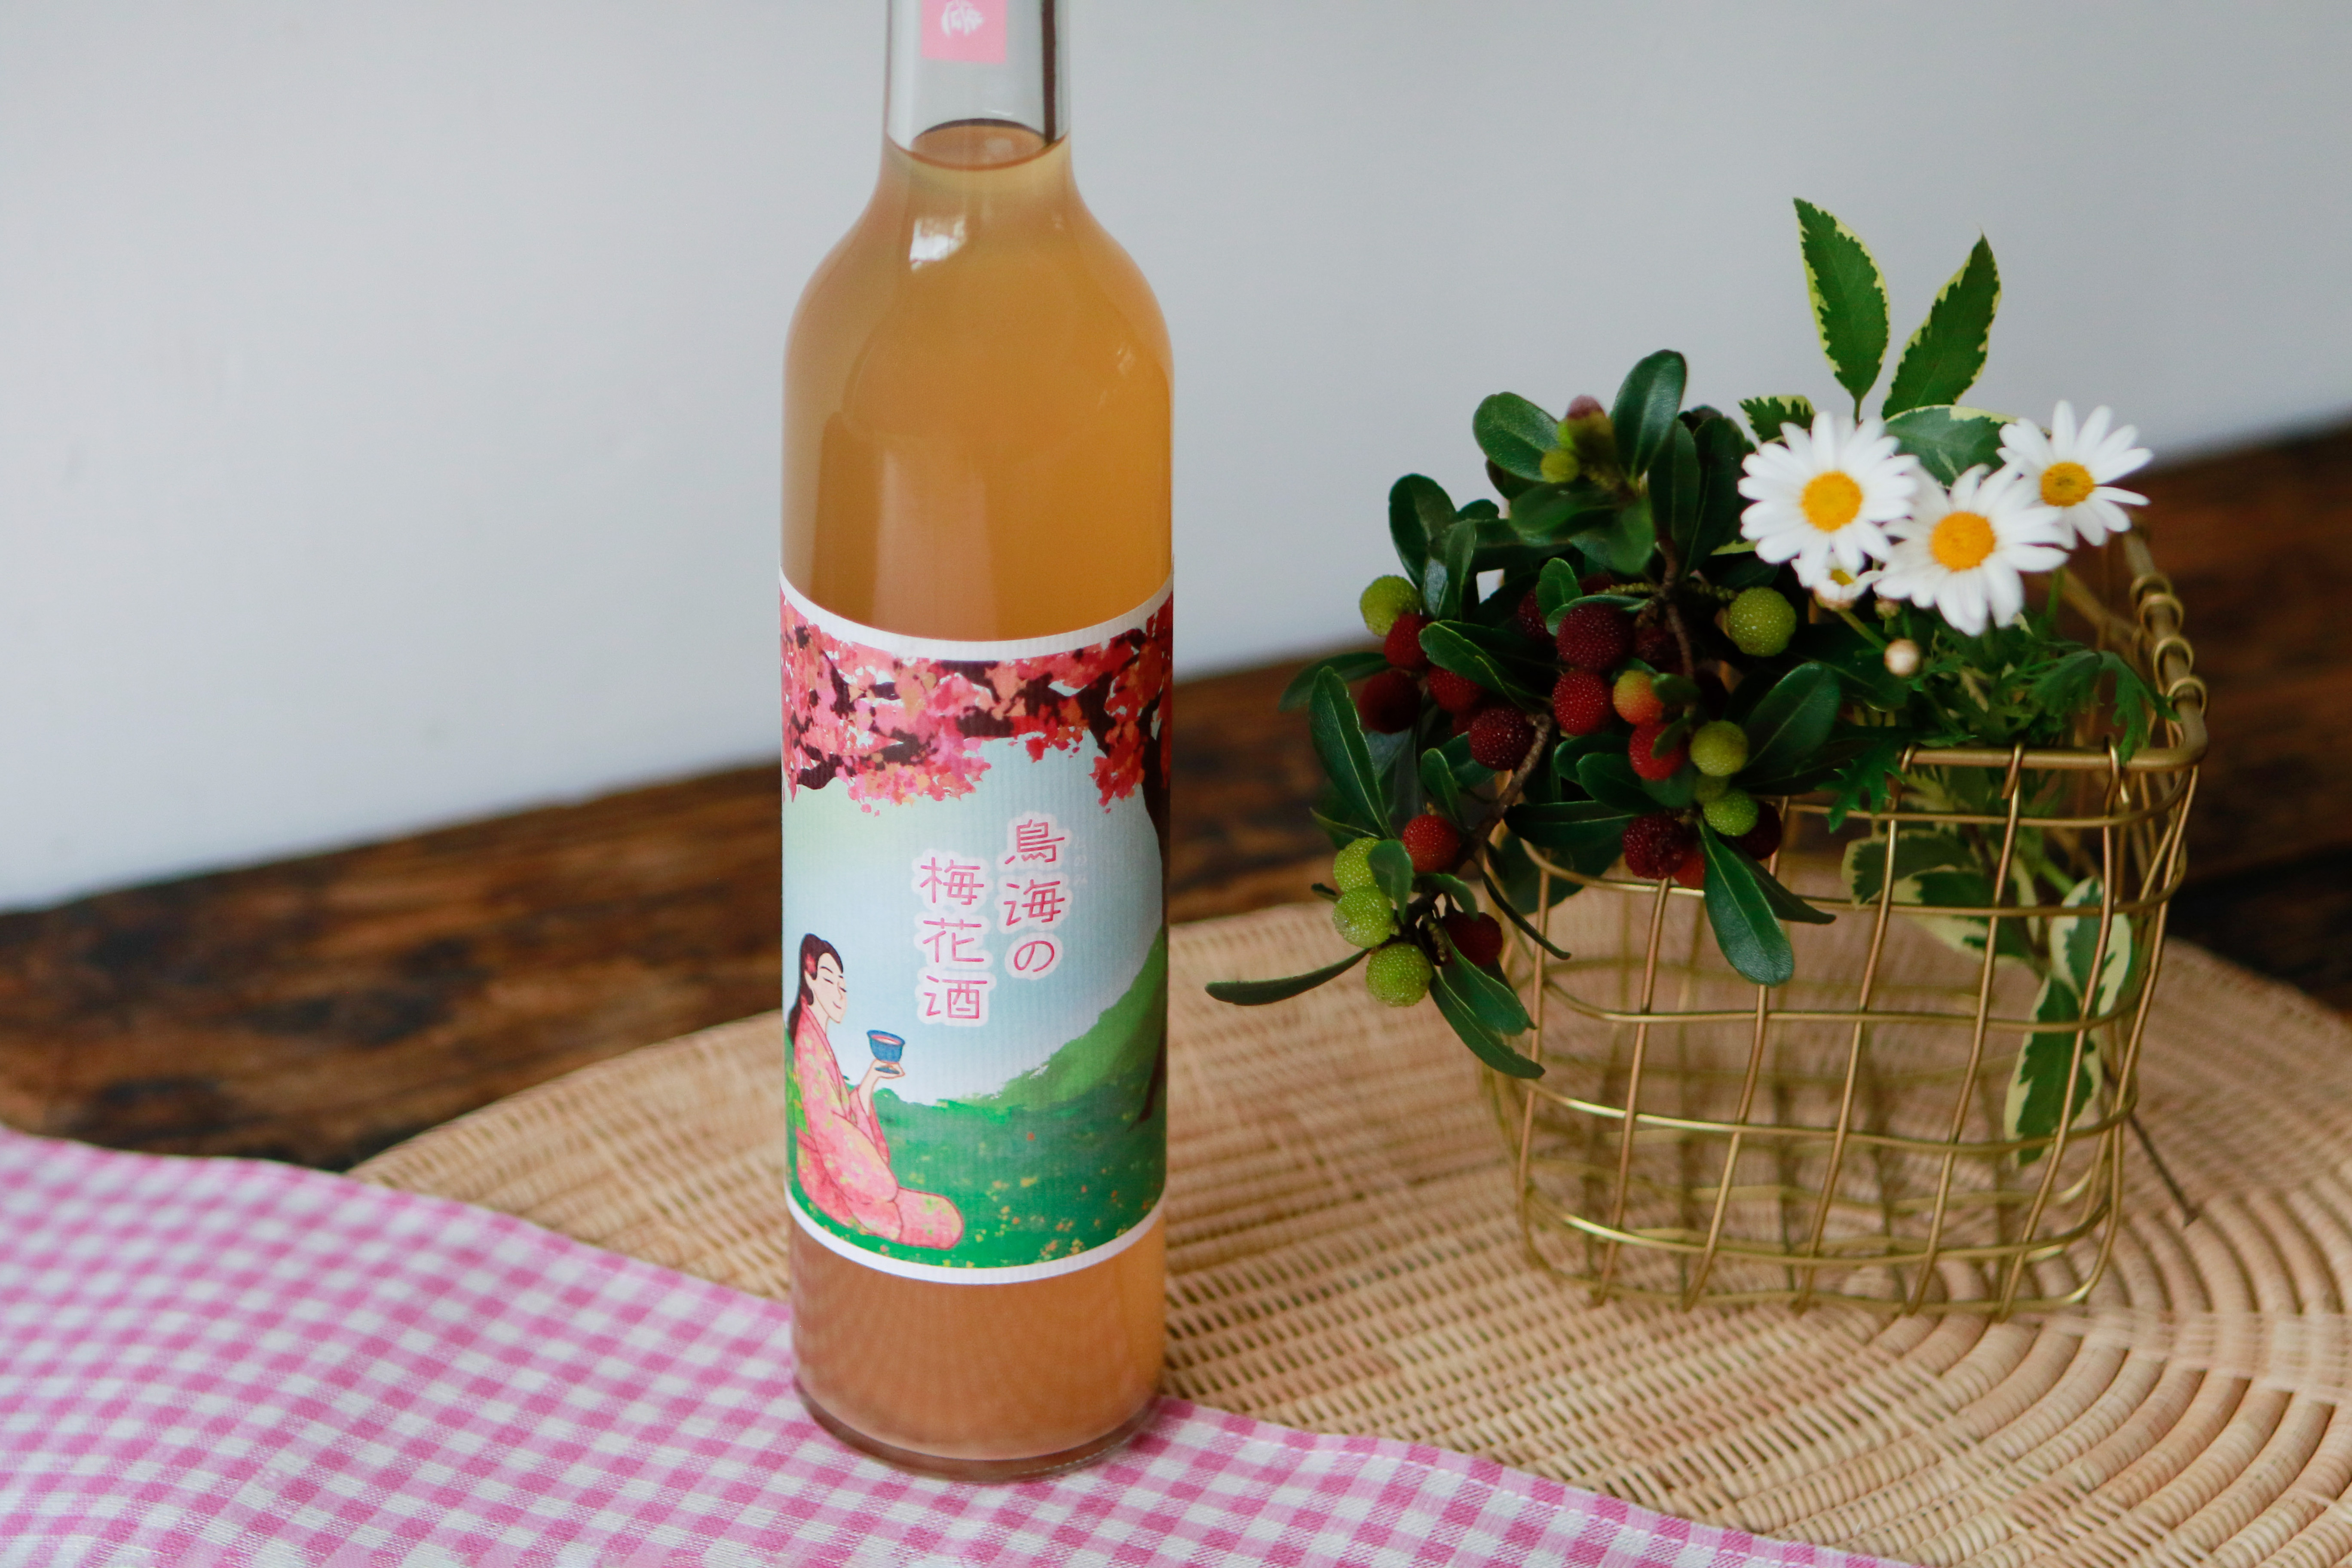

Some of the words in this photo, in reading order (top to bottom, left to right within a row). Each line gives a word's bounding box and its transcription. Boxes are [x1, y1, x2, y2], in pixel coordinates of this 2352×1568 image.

[919, 857, 988, 1019] 梅花酒
[1004, 819, 1065, 972] 鳥海の
